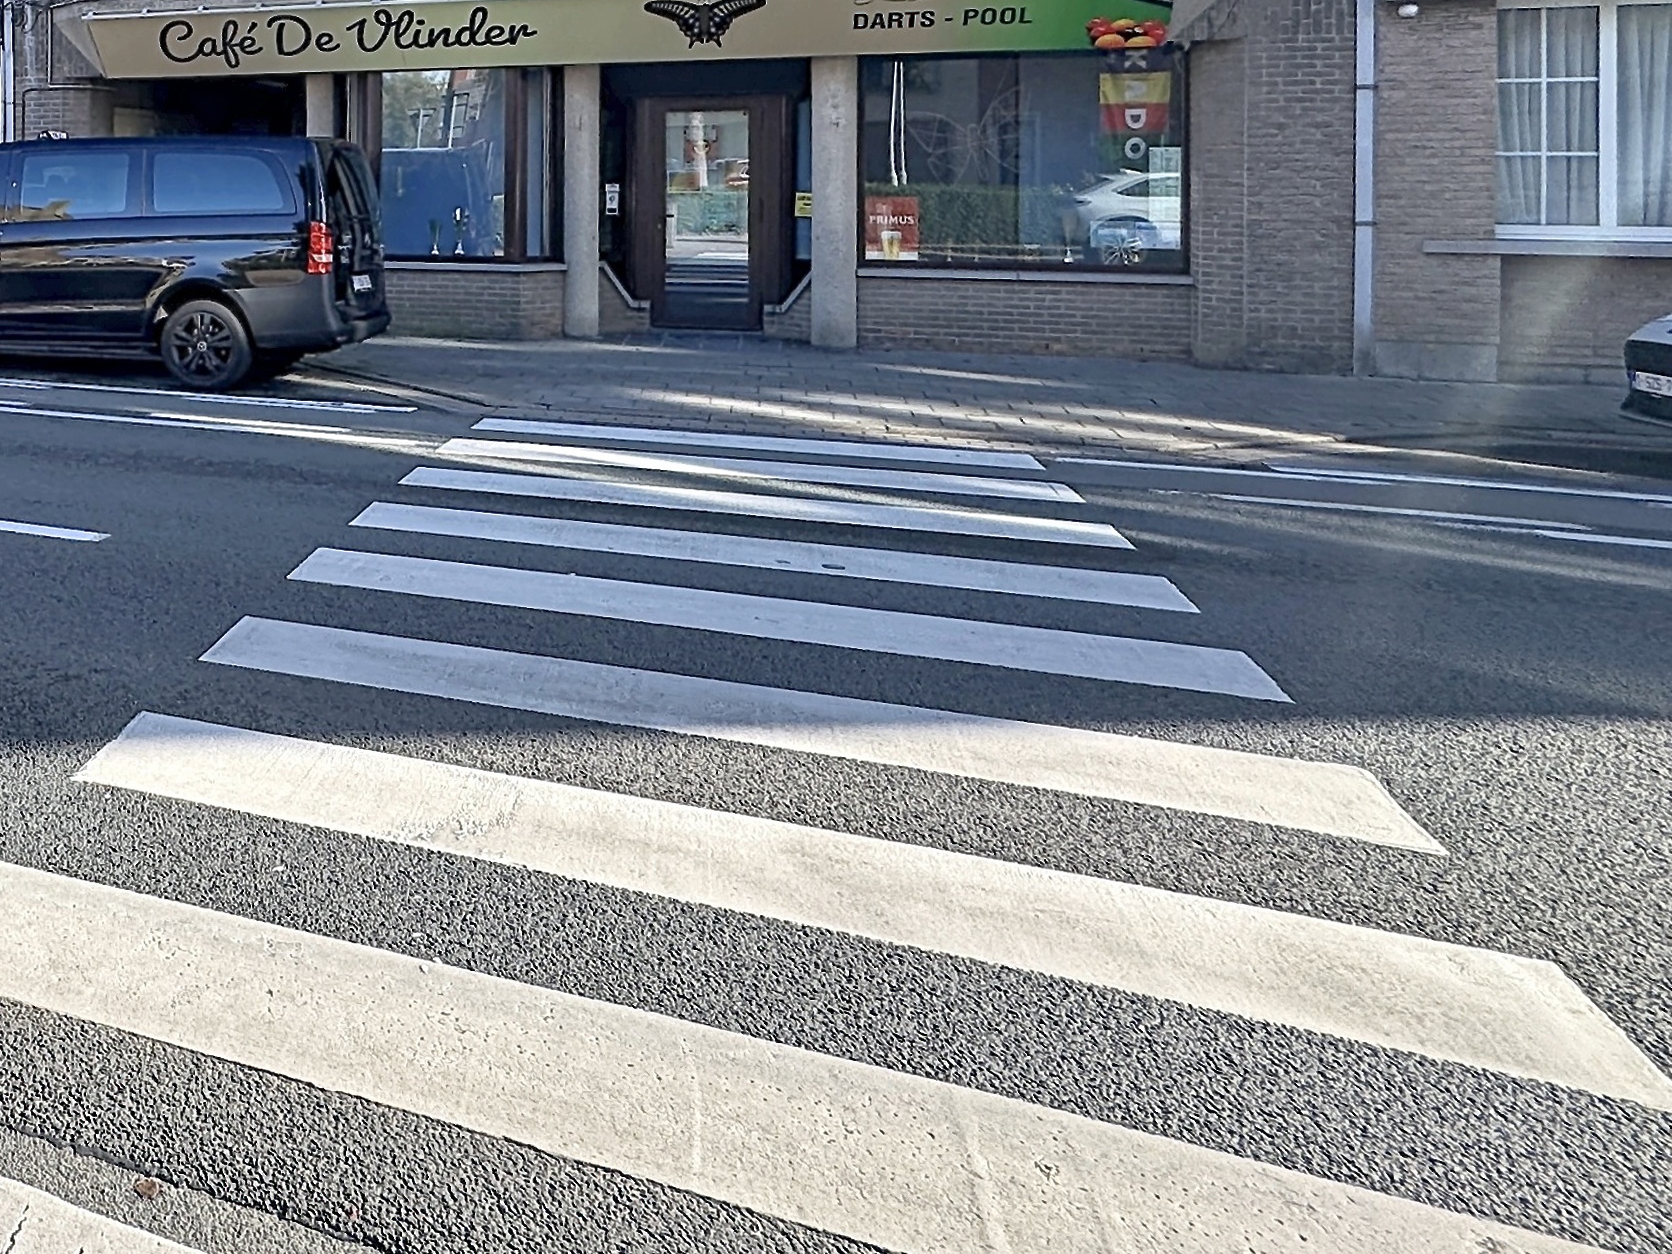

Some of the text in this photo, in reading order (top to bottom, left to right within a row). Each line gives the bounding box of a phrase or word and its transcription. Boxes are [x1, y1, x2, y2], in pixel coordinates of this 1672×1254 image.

[853, 10, 936, 30] DARTS
[962, 7, 1033, 26] POOL
[159, 6, 538, 69] Café De Vlinder
[869, 215, 915, 225] PRIMUS
